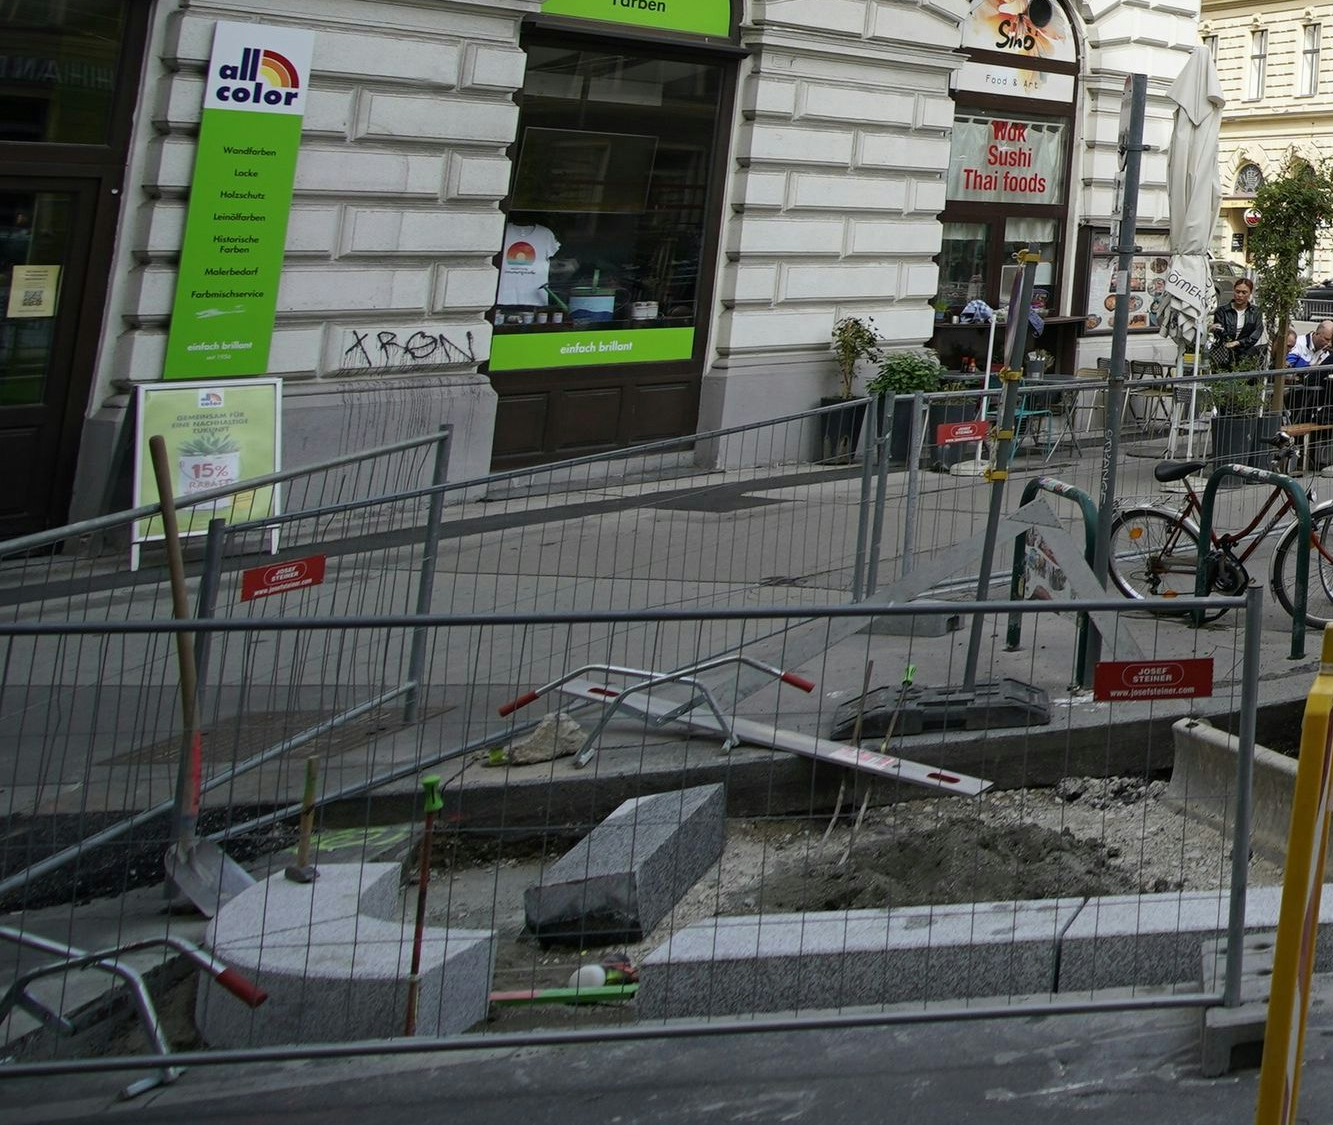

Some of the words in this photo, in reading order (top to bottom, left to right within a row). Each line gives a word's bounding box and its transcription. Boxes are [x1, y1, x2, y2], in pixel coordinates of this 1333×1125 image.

[219, 48, 261, 81] all
[985, 74, 1008, 86] Food
[1023, 80, 1039, 90] Art
[216, 82, 298, 106] color
[991, 120, 1028, 142] Wok
[223, 146, 277, 157] Wandfarben
[988, 145, 1032, 167] Sushi
[964, 169, 998, 191] Thai
[1003, 172, 1046, 193] foods
[220, 191, 265, 200] Holzschutz
[213, 212, 266, 222] Leinölfarben
[213, 235, 259, 244] Historische
[219, 246, 250, 254] Farben
[204, 266, 259, 276] Malerbedarf
[191, 290, 264, 299] Farbmischservice
[187, 342, 219, 352] einfach
[221, 340, 253, 350] brillant
[560, 342, 596, 354] einfach
[598, 340, 633, 352] brillant
[177, 413, 227, 421] GEMEINSAM
[192, 463, 229, 479] 15%
[1138, 667, 1168, 675] JOSEF
[1132, 675, 1173, 683] STEINER
[1110, 686, 1195, 697] www.josefsteiner.com
